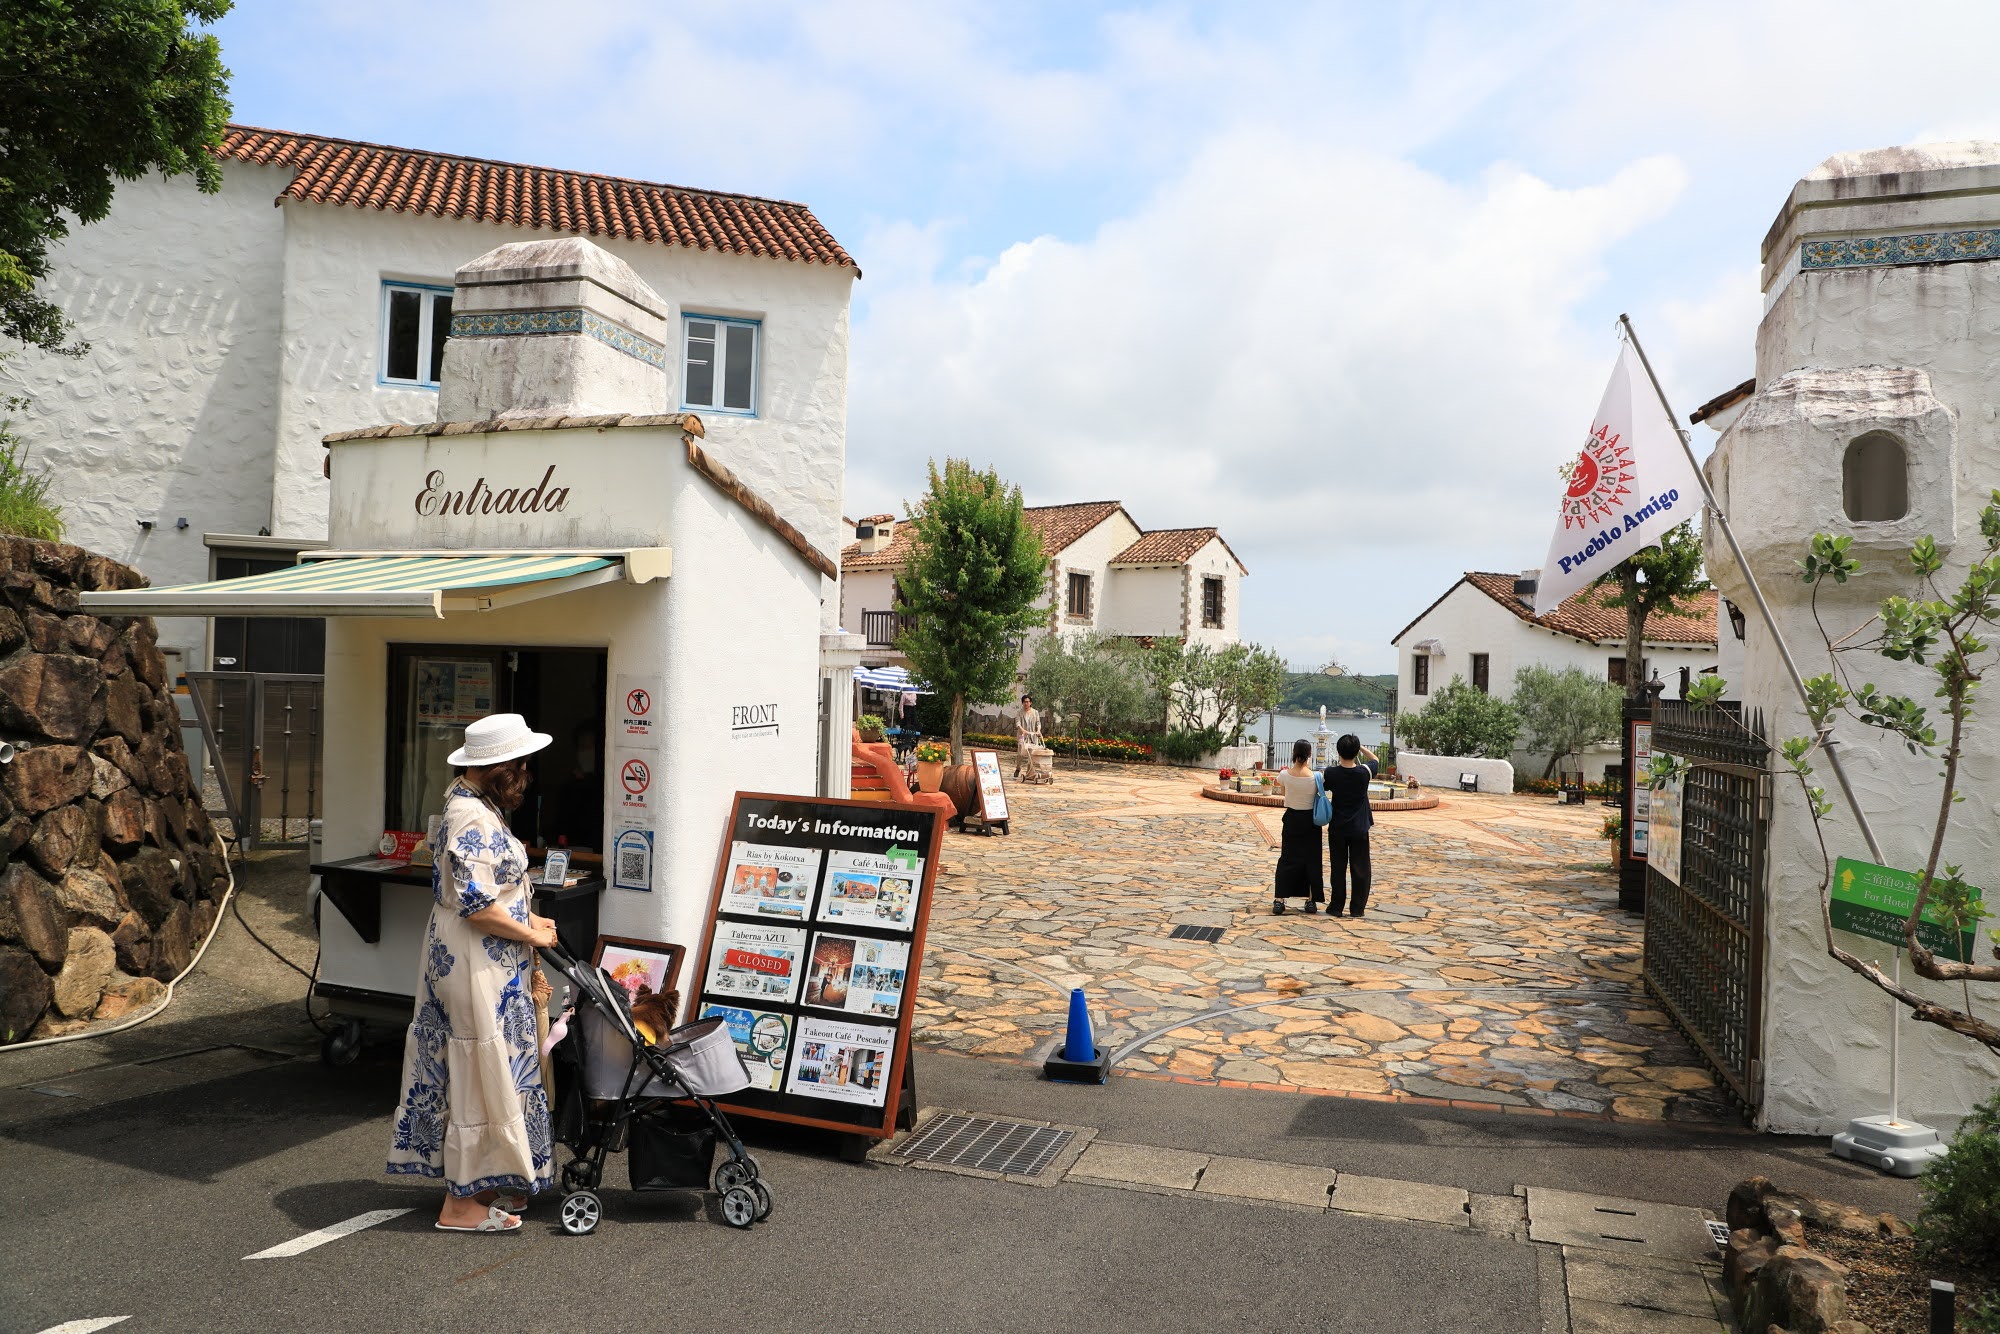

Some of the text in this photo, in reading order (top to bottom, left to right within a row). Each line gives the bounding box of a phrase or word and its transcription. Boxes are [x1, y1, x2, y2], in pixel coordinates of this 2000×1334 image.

[415, 464, 571, 517] Entrada
[1557, 488, 1679, 575] Pueblo Amigo
[732, 703, 778, 726] FRONT
[747, 813, 920, 842] Today's Information
[763, 851, 772, 862] by
[852, 858, 870, 868] Café
[872, 860, 898, 871] Amigo
[1863, 890, 1879, 902] For
[1883, 894, 1909, 910] Hotel
[731, 929, 762, 941] Taberna
[763, 933, 788, 943] AZUL
[1851, 922, 1869, 933] Please
[1869, 927, 1886, 937] check
[737, 954, 782, 971] CLOSED
[803, 1027, 833, 1039] Takeout
[834, 1031, 852, 1041] Café
[856, 1033, 889, 1046] Pescador
